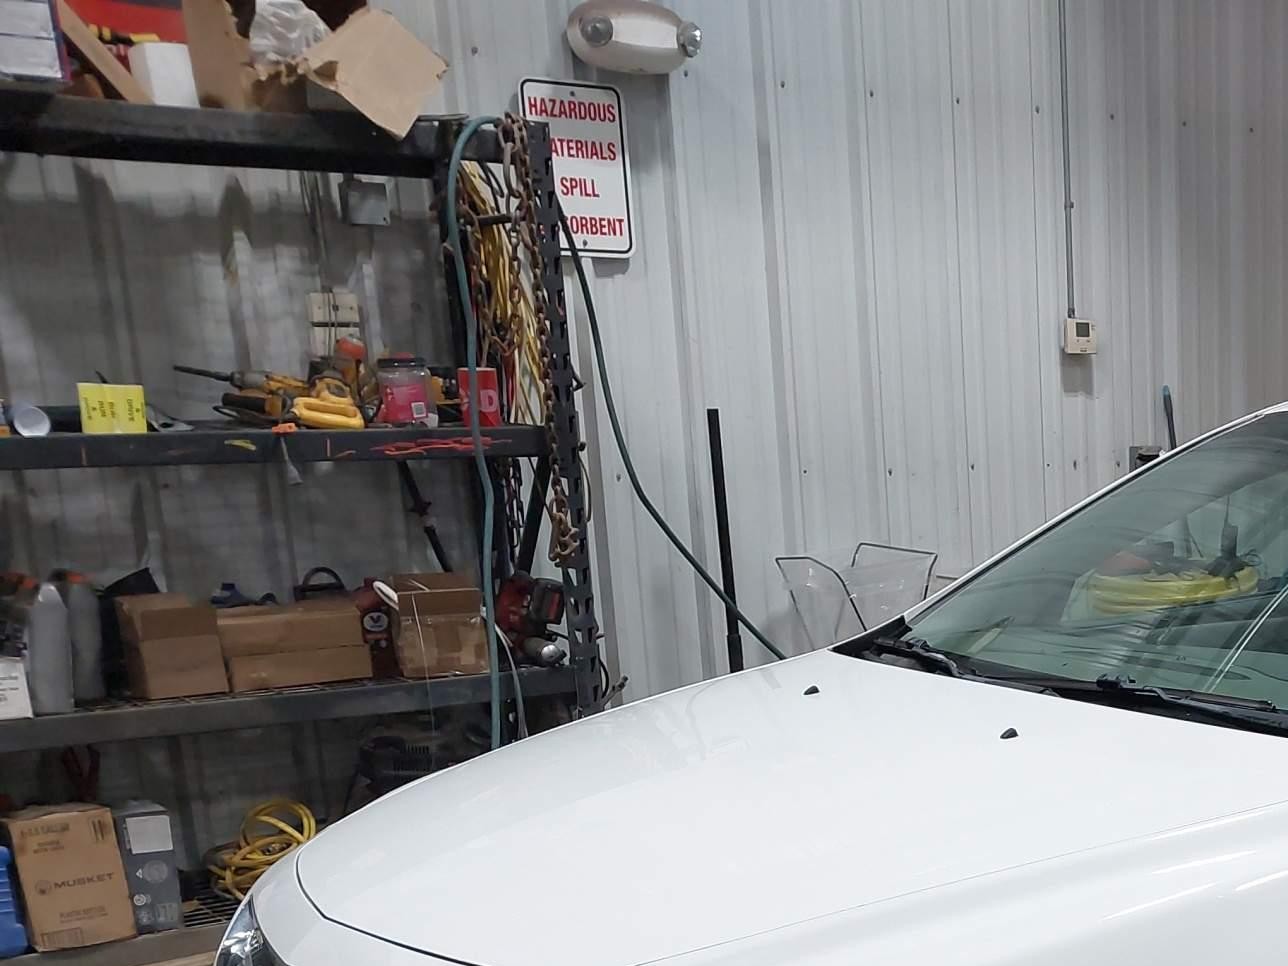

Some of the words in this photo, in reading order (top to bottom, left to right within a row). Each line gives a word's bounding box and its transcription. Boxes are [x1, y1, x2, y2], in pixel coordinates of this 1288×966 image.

[528, 97, 616, 123] HAZARDOUS
[551, 138, 617, 161] ATERIALS
[560, 177, 600, 198] SPILL
[555, 216, 625, 237] ORBENT
[54, 872, 114, 889] MUSKET
